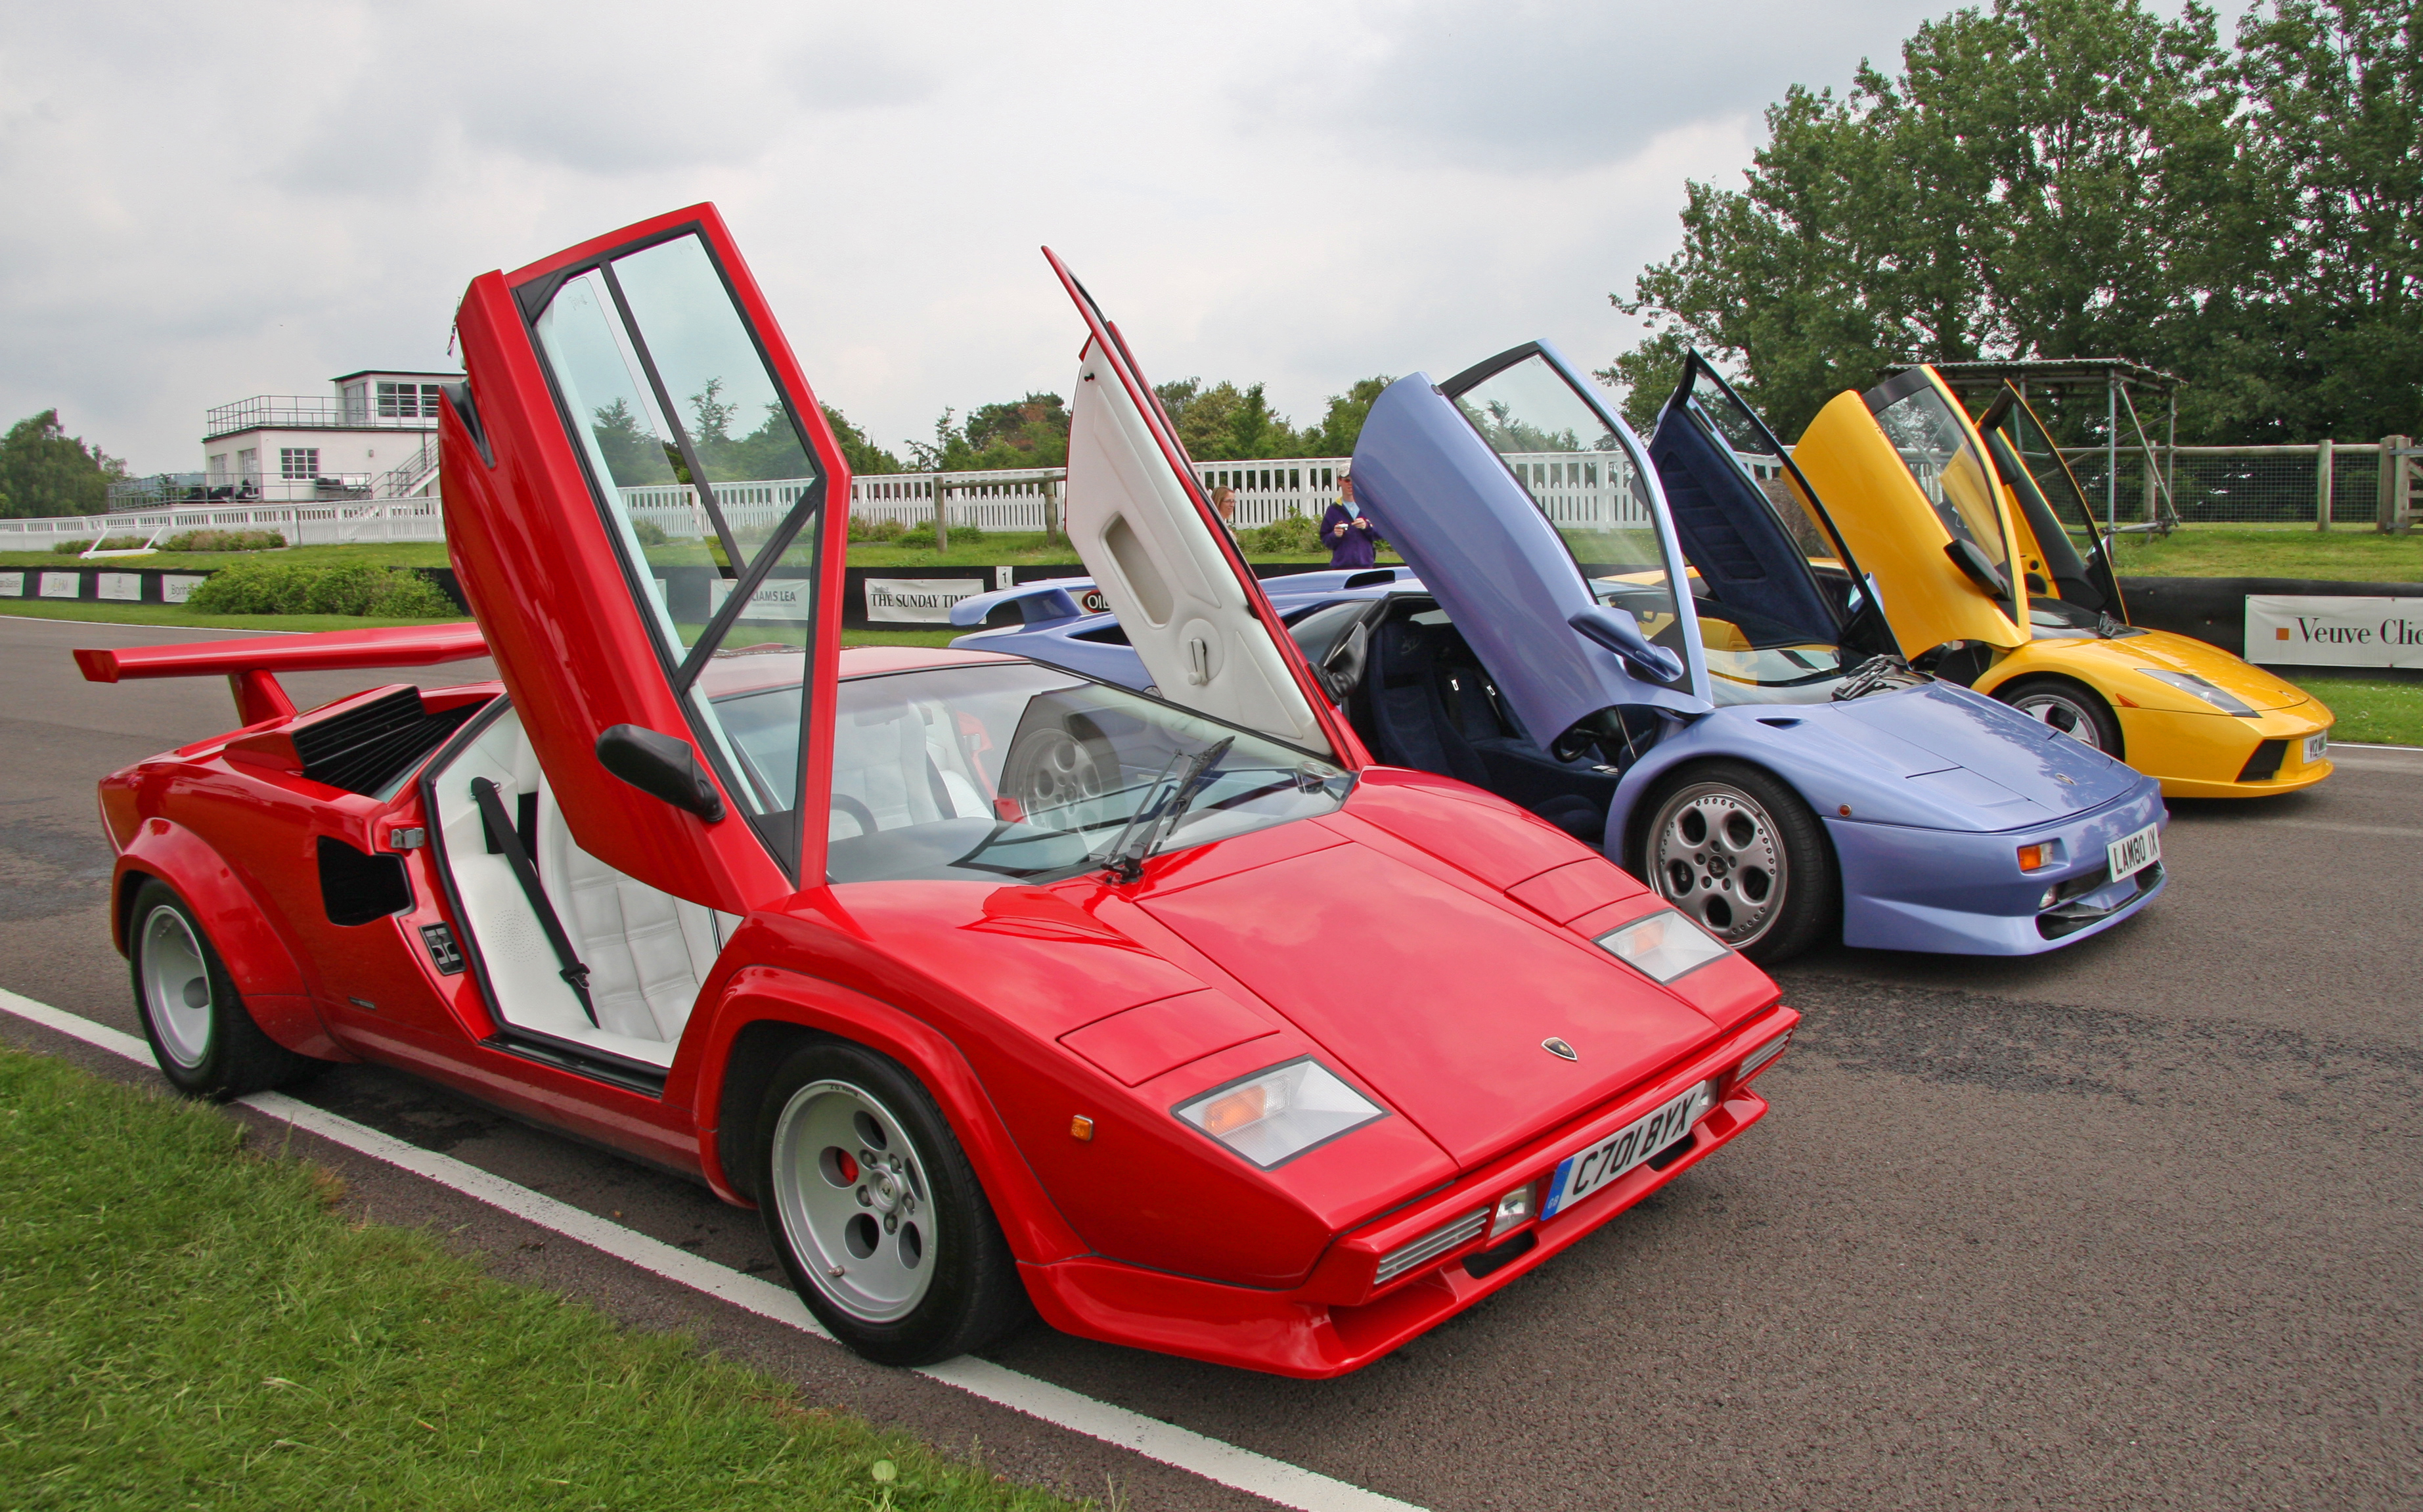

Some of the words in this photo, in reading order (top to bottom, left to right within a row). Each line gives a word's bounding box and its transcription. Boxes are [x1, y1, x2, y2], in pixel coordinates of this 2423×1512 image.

[1002, 571, 1007, 583] 1
[780, 590, 797, 602] LEA
[870, 594, 894, 608] THE
[895, 594, 940, 608] SUNDAY
[942, 594, 977, 608] TIM
[2296, 617, 2371, 644] Veuve
[1572, 1124, 1643, 1196] C701
[1638, 1092, 1697, 1159] BYX
[1547, 1195, 1560, 1210] GB
